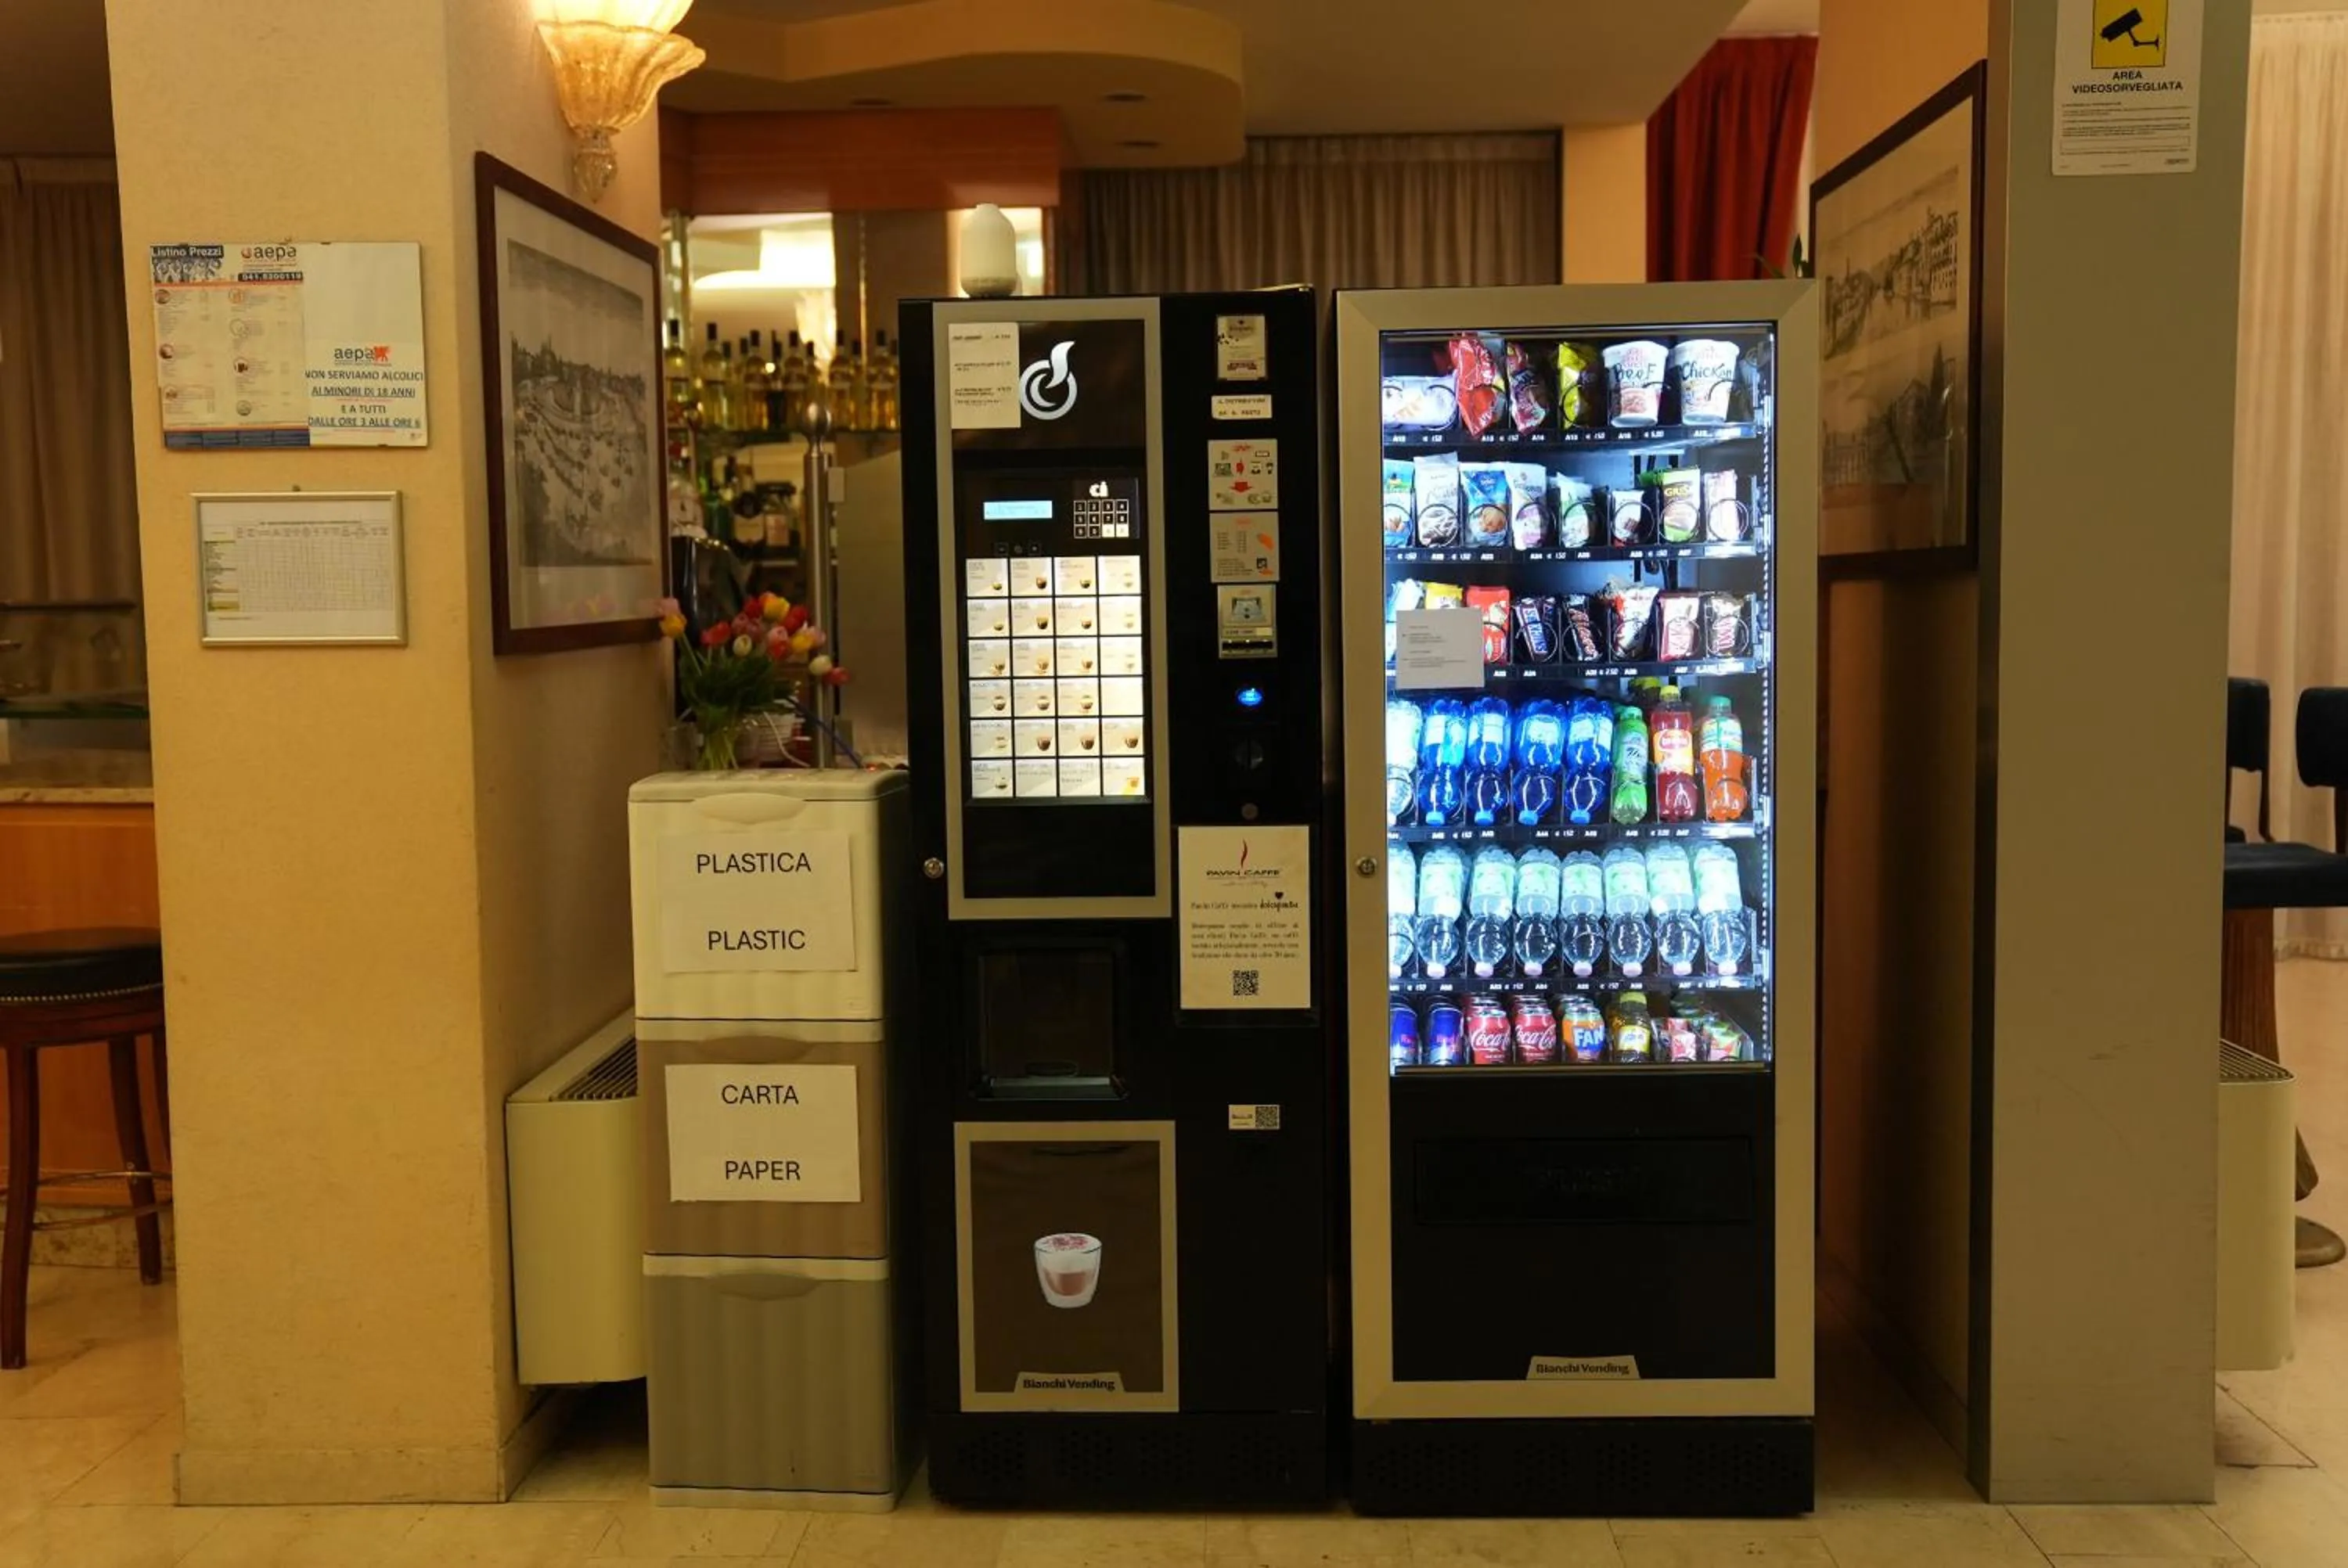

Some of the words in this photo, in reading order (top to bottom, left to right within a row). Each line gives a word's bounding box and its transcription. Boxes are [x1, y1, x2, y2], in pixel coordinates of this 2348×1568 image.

[2112, 70, 2143, 80] AREA
[2072, 81, 2183, 93] VIDEOSORVEGLIATA
[151, 246, 186, 257] Listino
[189, 246, 222, 257] Prezzi
[254, 245, 297, 261] aepa
[334, 347, 374, 361] aepa
[328, 370, 380, 379] SERVIAMO
[381, 371, 423, 380] ALCOLICI
[324, 387, 362, 396] MINORI
[391, 387, 416, 397] ANNI
[349, 405, 357, 414] A
[359, 405, 387, 414] TUTTI
[308, 417, 335, 426] DALLE
[338, 417, 357, 426] ORE
[369, 417, 390, 427] ALLE
[393, 418, 412, 428] ORE
[697, 852, 812, 873] PLASTICA
[708, 930, 805, 951] PLASTIC
[721, 1084, 799, 1105] CARTA
[725, 1160, 801, 1181] PAPER
[1536, 1363, 1579, 1374] Bianchi
[1581, 1362, 1630, 1376] Vending
[1023, 1378, 1066, 1389] Bianchi
[1067, 1378, 1116, 1392] Vending
